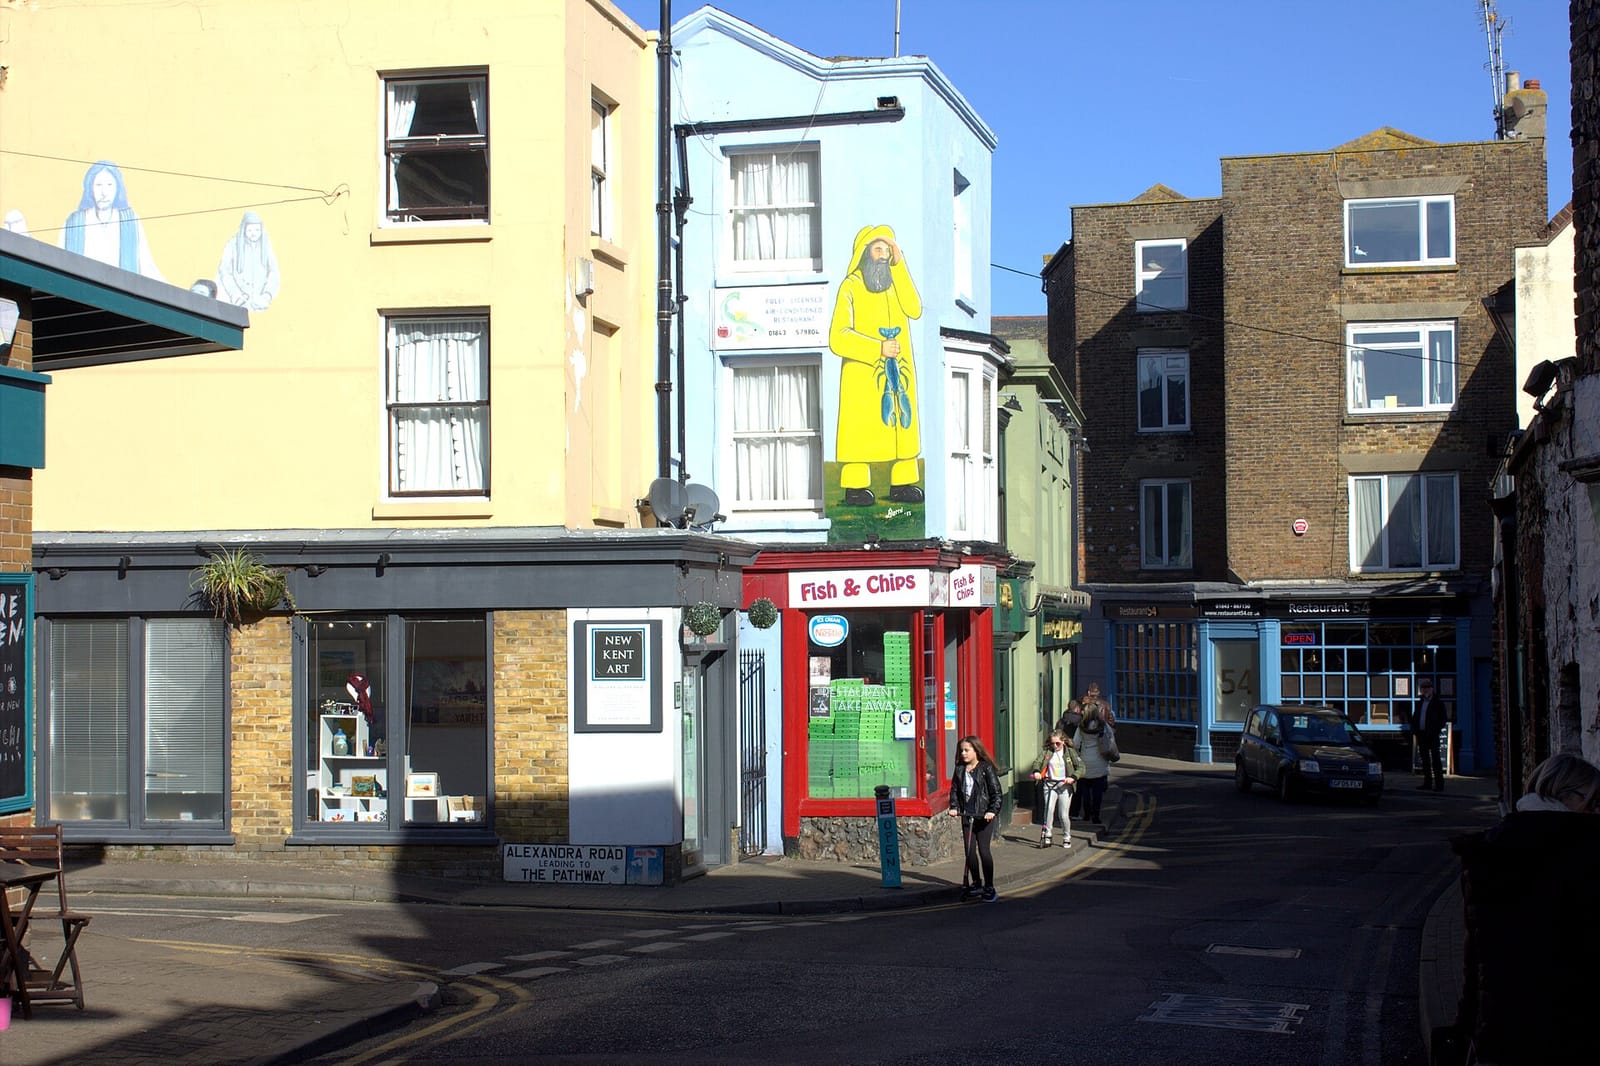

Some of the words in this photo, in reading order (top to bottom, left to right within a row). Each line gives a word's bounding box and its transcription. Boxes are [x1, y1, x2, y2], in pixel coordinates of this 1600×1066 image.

[801, 580, 838, 602] Fish
[843, 578, 861, 597] &
[866, 573, 916, 594] Chips
[953, 576, 968, 590] Fish
[968, 573, 975, 584] &
[956, 587, 975, 601] Chips
[1289, 603, 1350, 613] Restaurant
[1353, 601, 1370, 614] 54
[605, 636, 632, 645] NEW
[1284, 635, 1313, 643] OPEN
[603, 650, 634, 660] KENT
[606, 664, 630, 673] ART
[1221, 669, 1252, 695] 54
[823, 686, 898, 698] RESTAURANT
[833, 700, 861, 711] TAKE
[865, 700, 901, 712] AWAY
[883, 820, 895, 866] OPEN
[506, 846, 583, 860] ALEXANDRA
[589, 848, 624, 860] ROAD
[538, 860, 575, 868] LEADING
[521, 868, 546, 880] THE
[552, 869, 606, 882] PATHWAY
